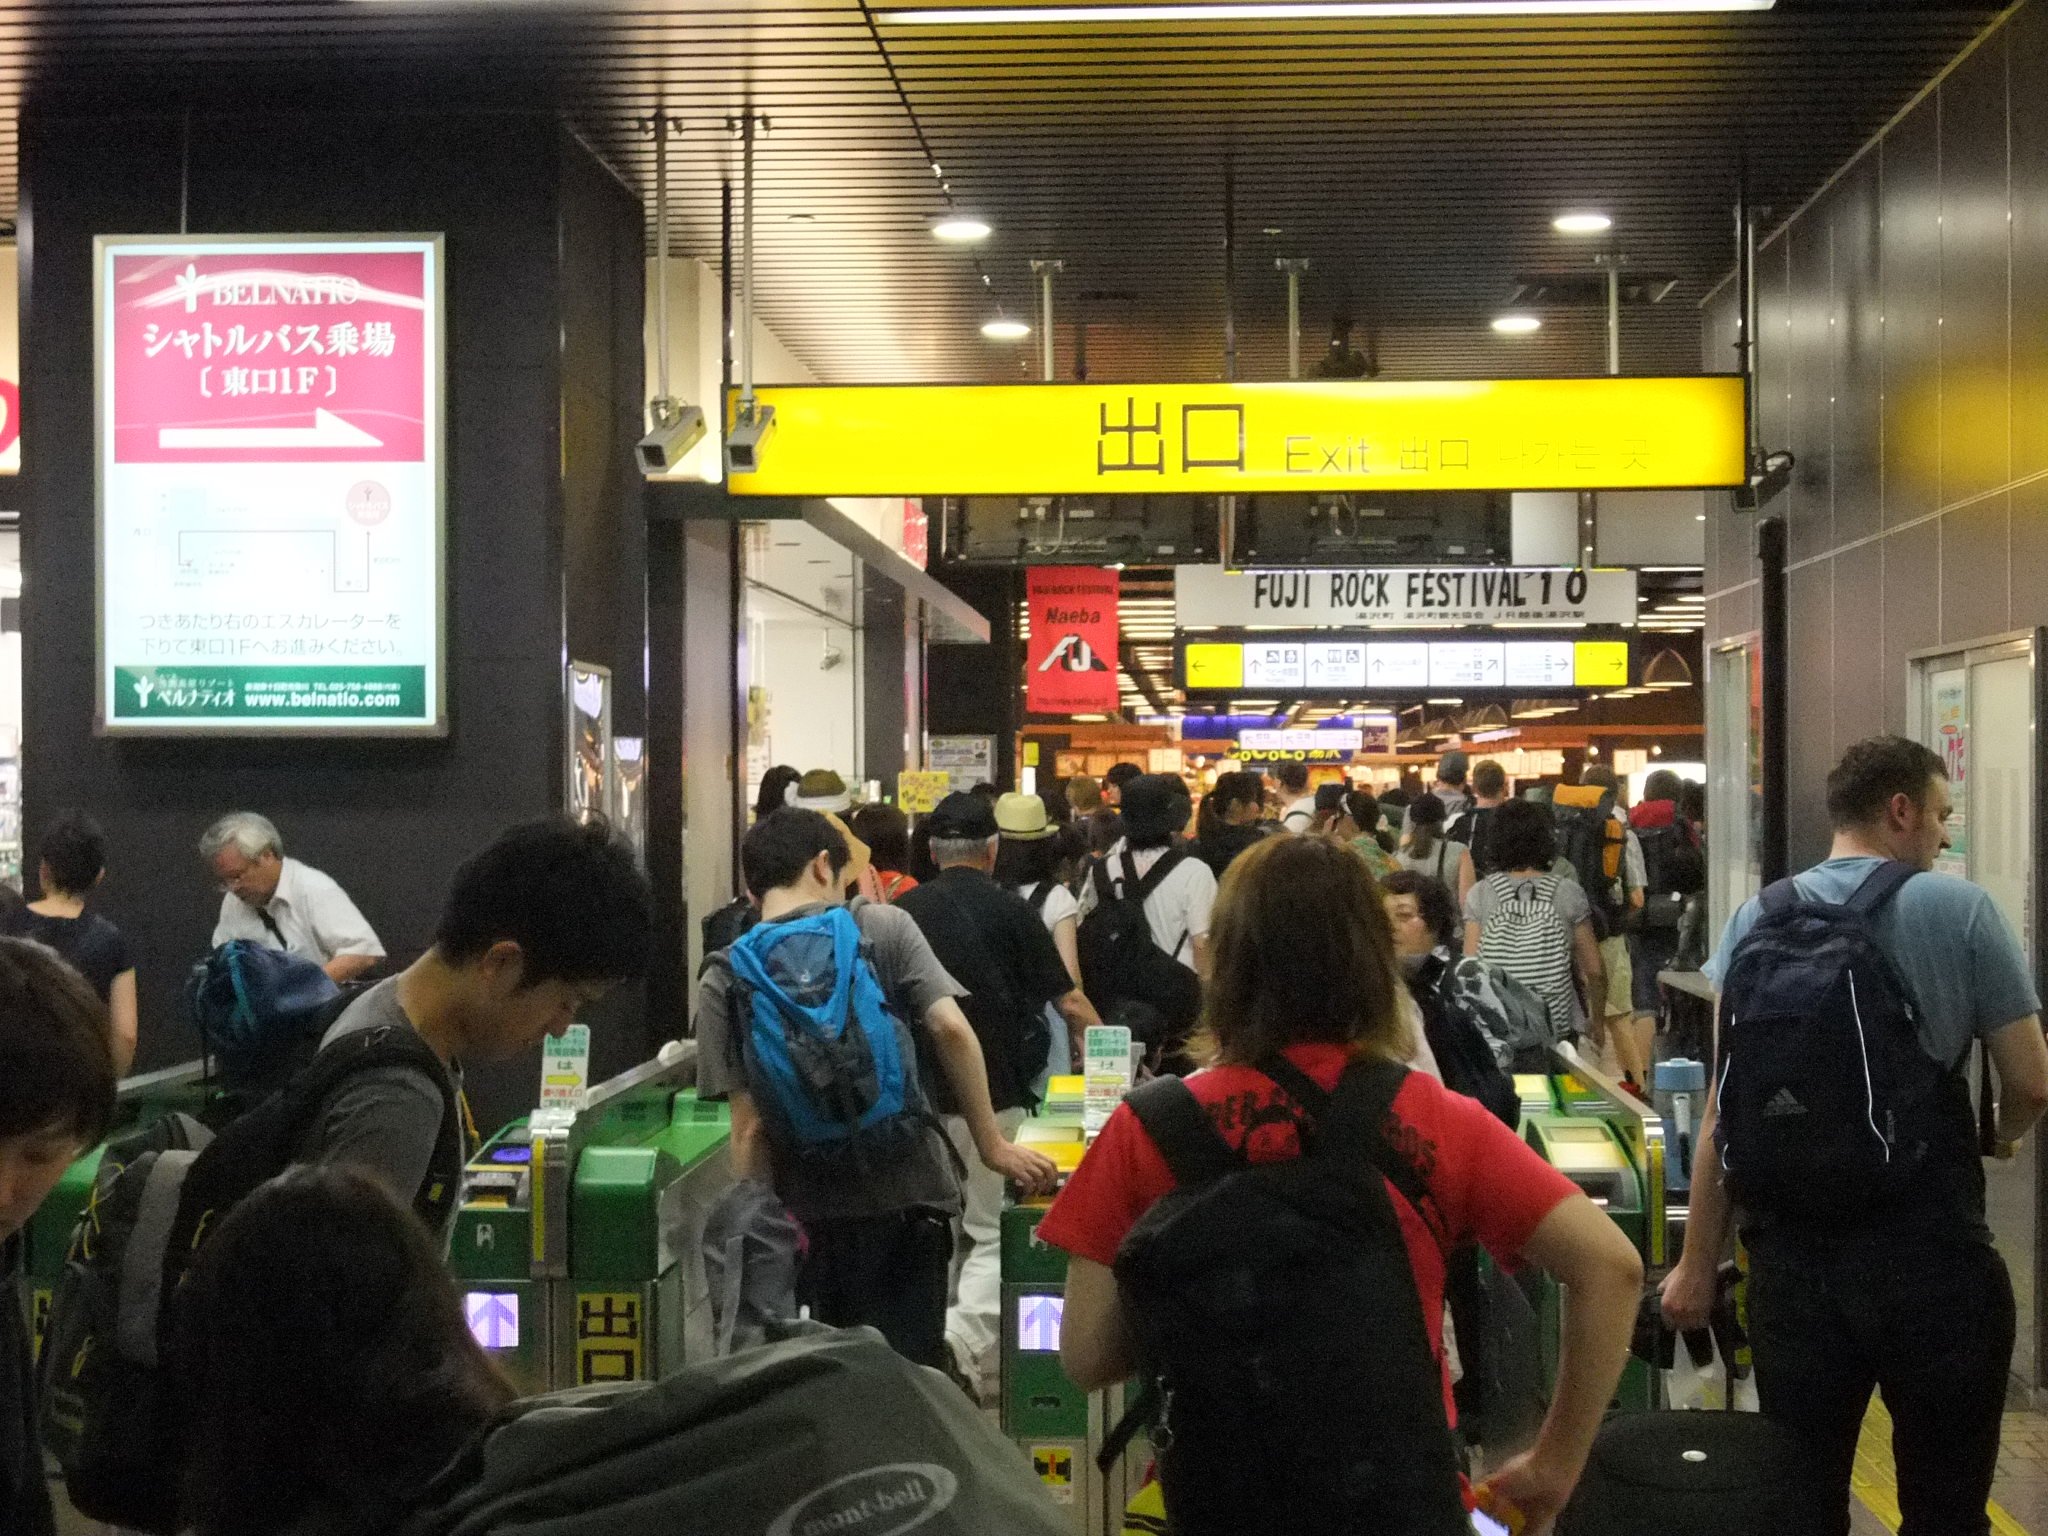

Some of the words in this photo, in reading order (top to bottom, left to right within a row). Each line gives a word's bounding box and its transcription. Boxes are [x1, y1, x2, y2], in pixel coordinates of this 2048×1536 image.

[142, 321, 396, 359] シャトルバス乗場
[1098, 397, 1245, 475] 出口
[1286, 435, 1371, 474] Exit
[1399, 435, 1469, 472] 出口
[1254, 573, 1311, 609] FUJI
[1331, 572, 1390, 608] ROCK
[139, 613, 402, 631] つきあたり右のエスカレーターを
[1046, 607, 1101, 624] Naeba
[579, 1297, 637, 1384] 出口
